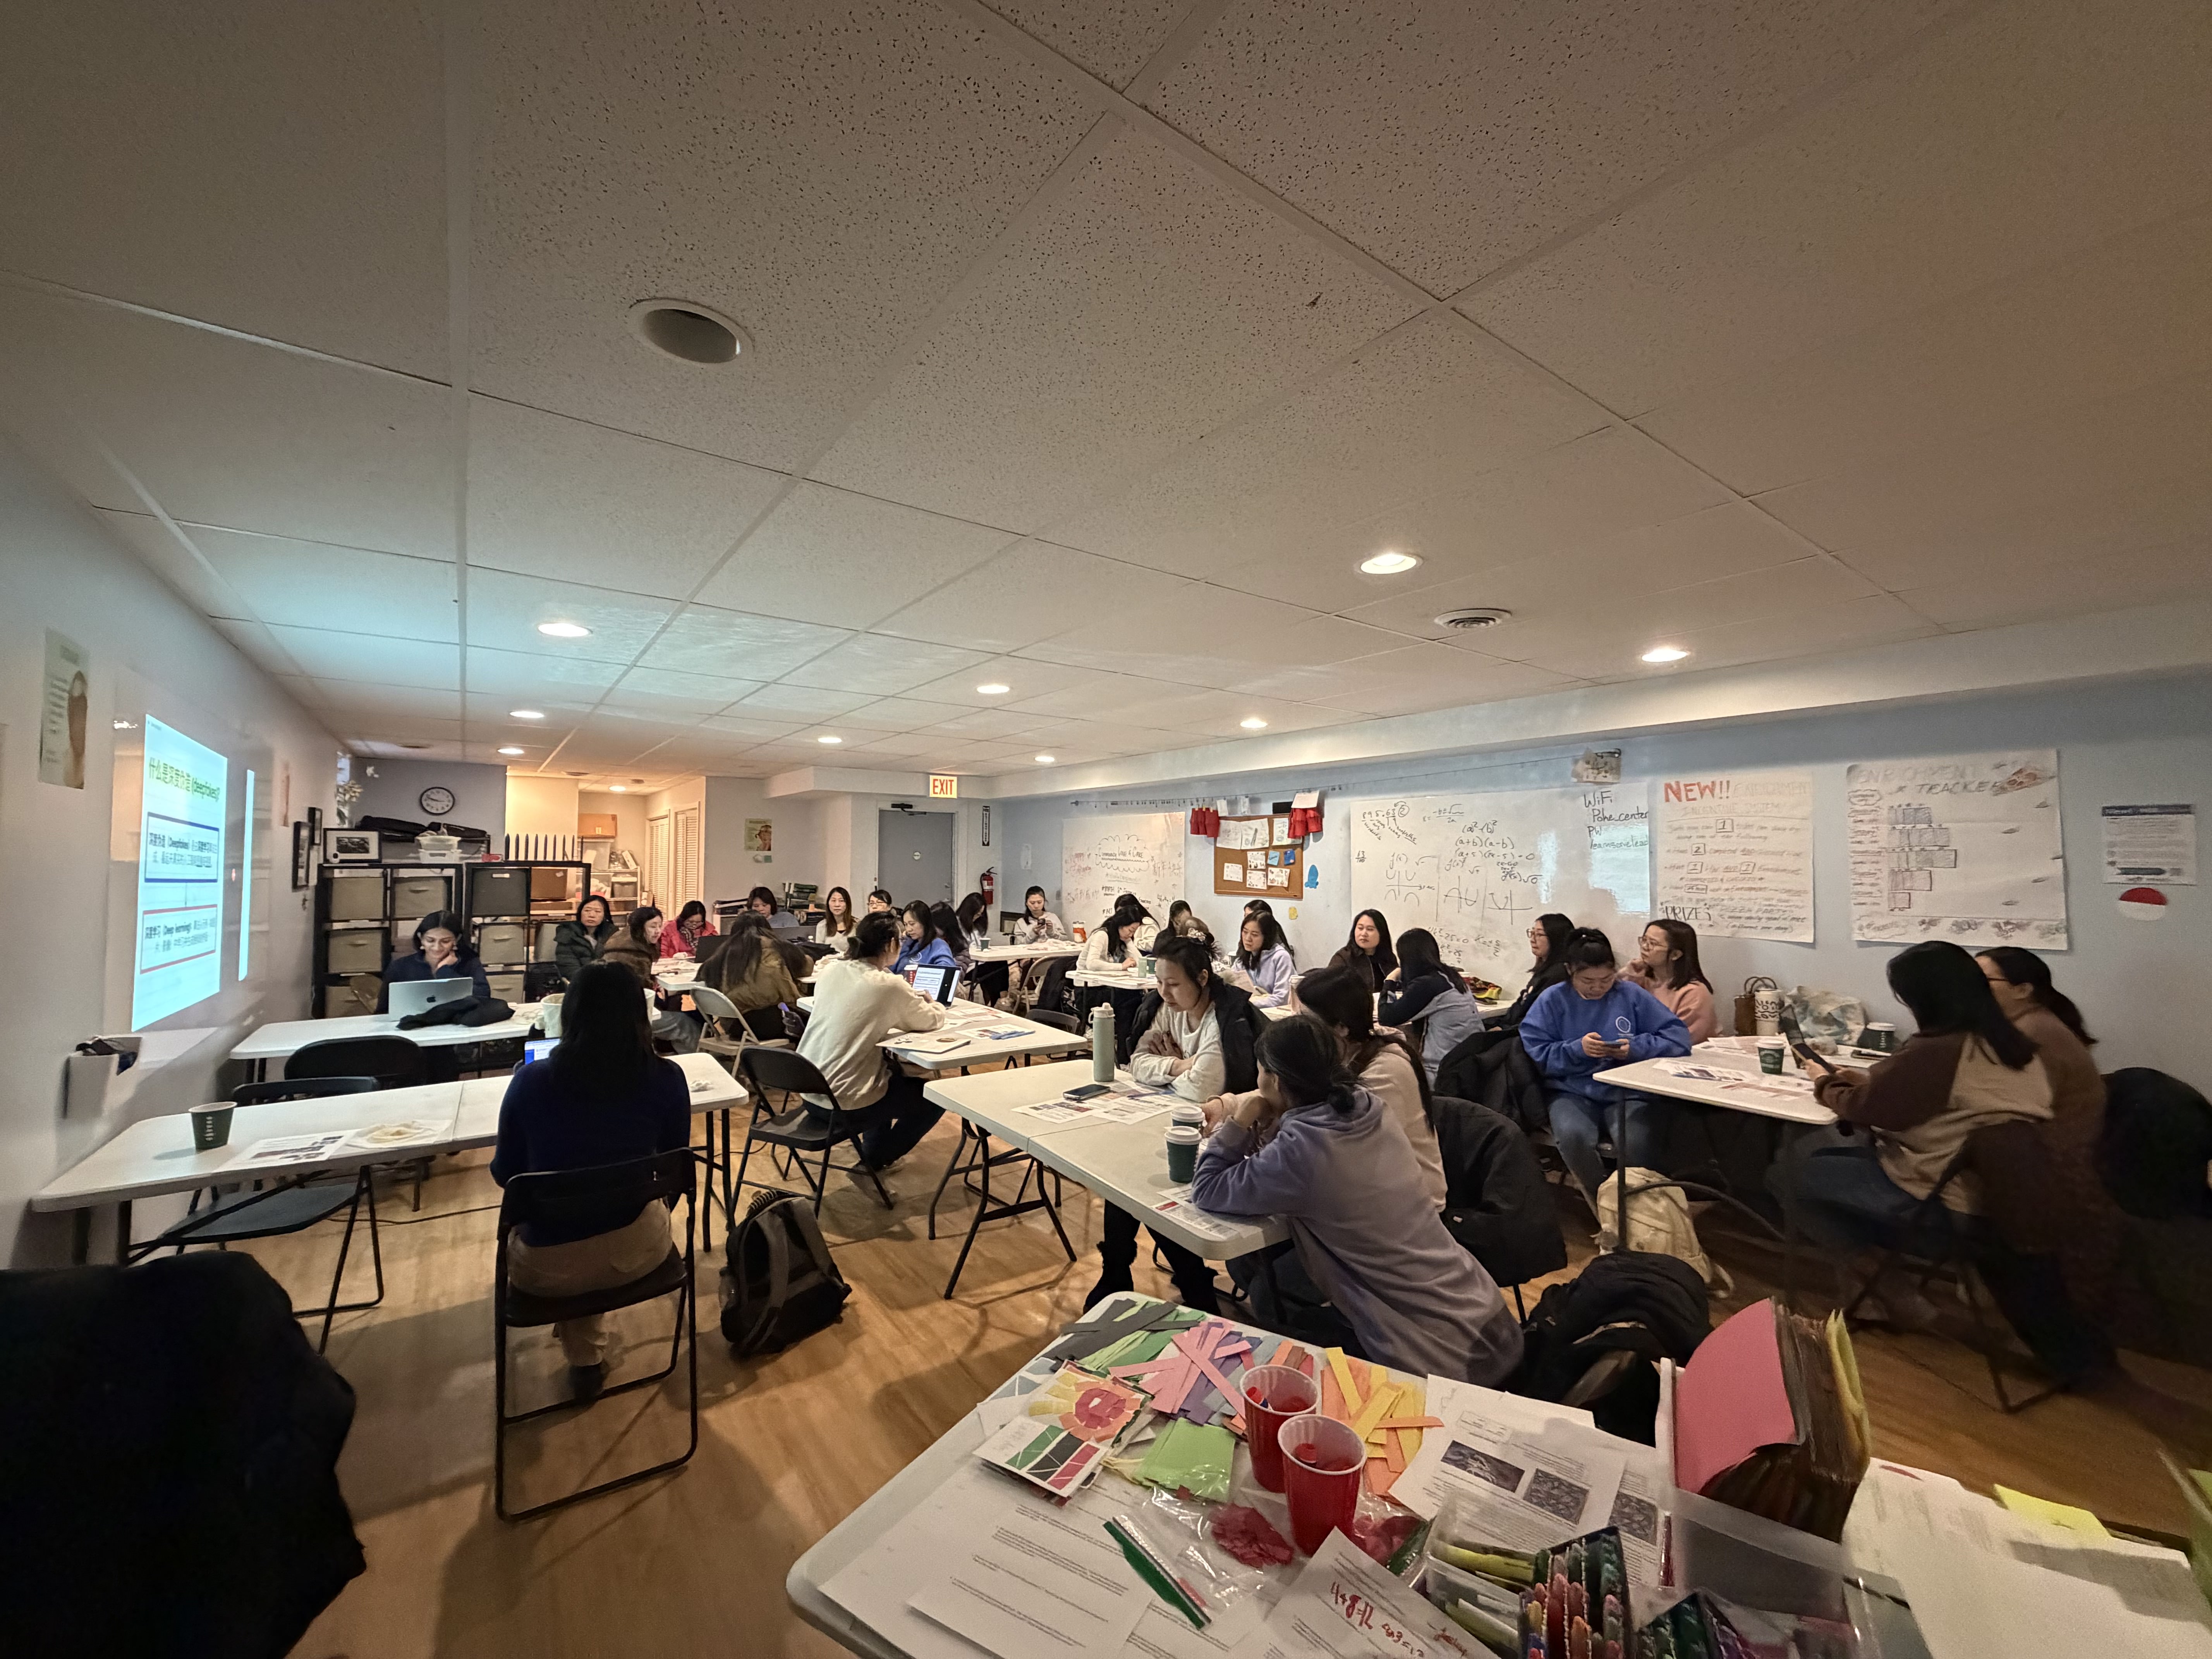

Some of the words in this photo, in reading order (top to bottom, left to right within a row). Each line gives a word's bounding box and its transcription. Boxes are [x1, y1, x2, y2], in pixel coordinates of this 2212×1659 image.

[933, 779, 954, 795] EXIT
[1664, 780, 1730, 802] NEW!!
[1584, 790, 1613, 808] WiFi
[1587, 826, 1602, 838] PW
[1665, 905, 1712, 922] PRIZES
